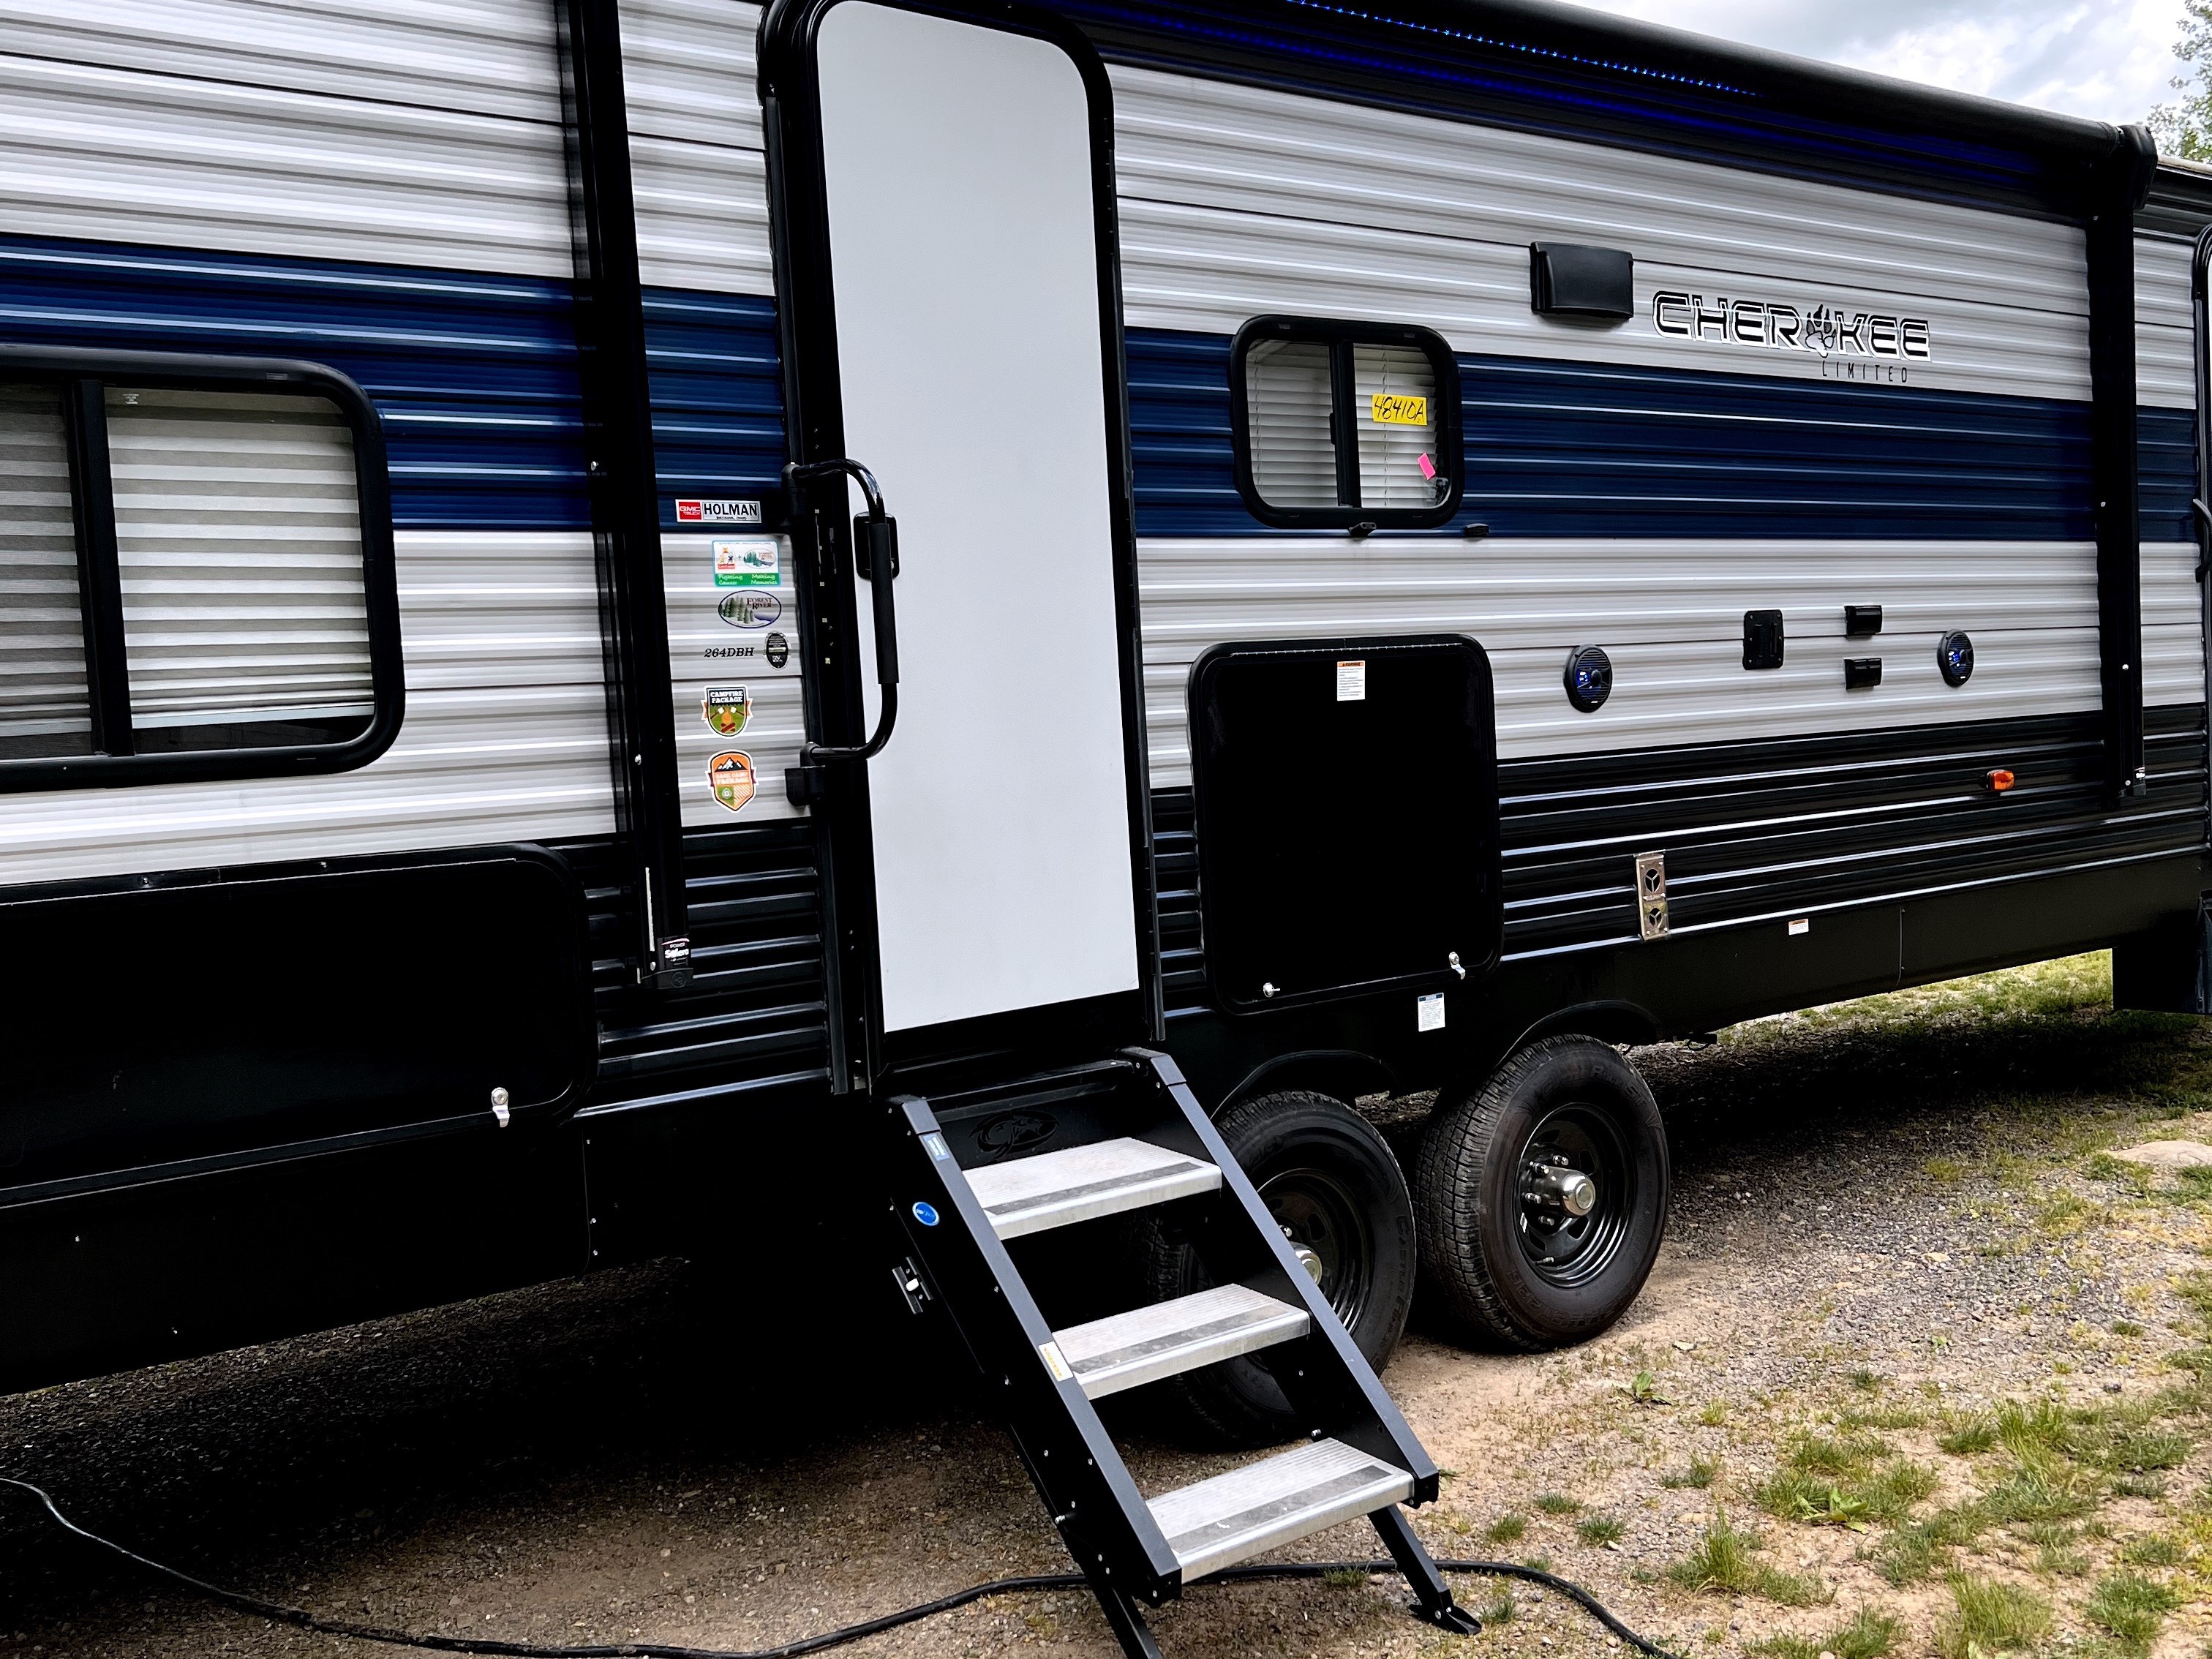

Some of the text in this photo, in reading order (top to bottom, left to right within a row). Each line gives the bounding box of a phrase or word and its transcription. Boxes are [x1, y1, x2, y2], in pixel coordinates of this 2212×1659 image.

[1822, 360, 1908, 383] LIMITED
[1374, 396, 1425, 422] 48410A
[704, 503, 758, 516] HOLMAN
[746, 598, 772, 606] FOREST
[704, 647, 755, 658] 264DBH
